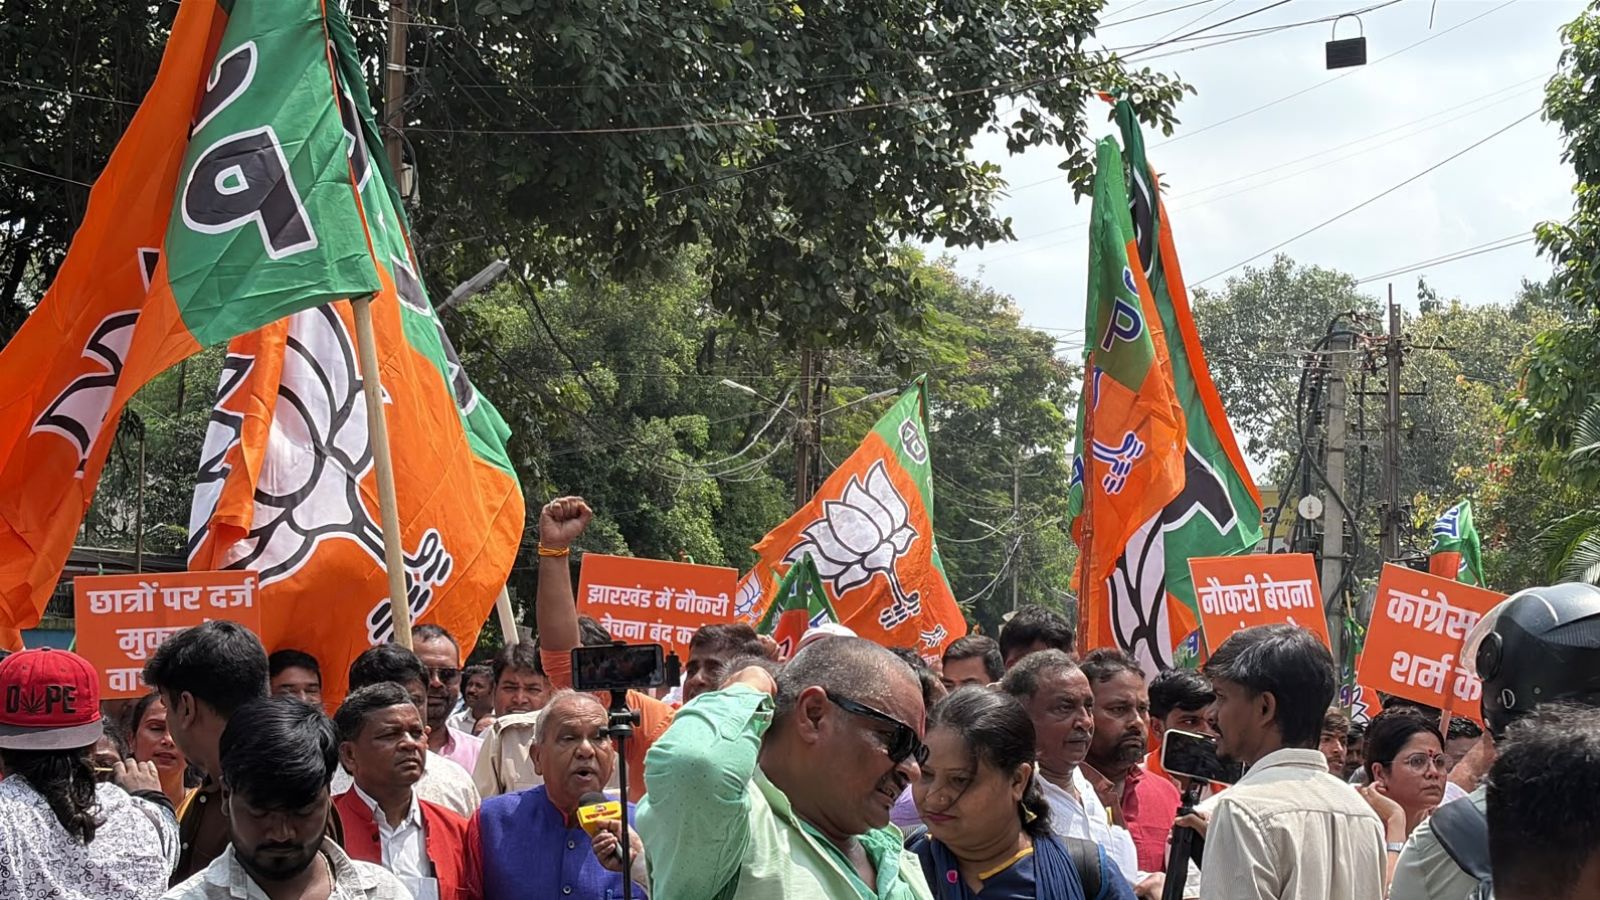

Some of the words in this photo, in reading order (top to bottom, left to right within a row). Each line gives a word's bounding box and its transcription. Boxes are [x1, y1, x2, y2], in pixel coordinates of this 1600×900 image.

[87, 581, 158, 615] छात्रों
[160, 587, 202, 611] पर
[207, 577, 256, 608] दर्ज
[587, 584, 653, 608] झारखंड
[655, 586, 675, 610] में
[675, 588, 730, 616] नौकरी
[1198, 574, 1262, 615] नौकरी
[1260, 573, 1315, 610] बेचना
[600, 612, 648, 640] बेचना
[649, 618, 674, 643] बंद
[1387, 588, 1481, 642] कांग्रेस
[1390, 650, 1454, 694] शर्म
[6, 684, 76, 714] DPE
